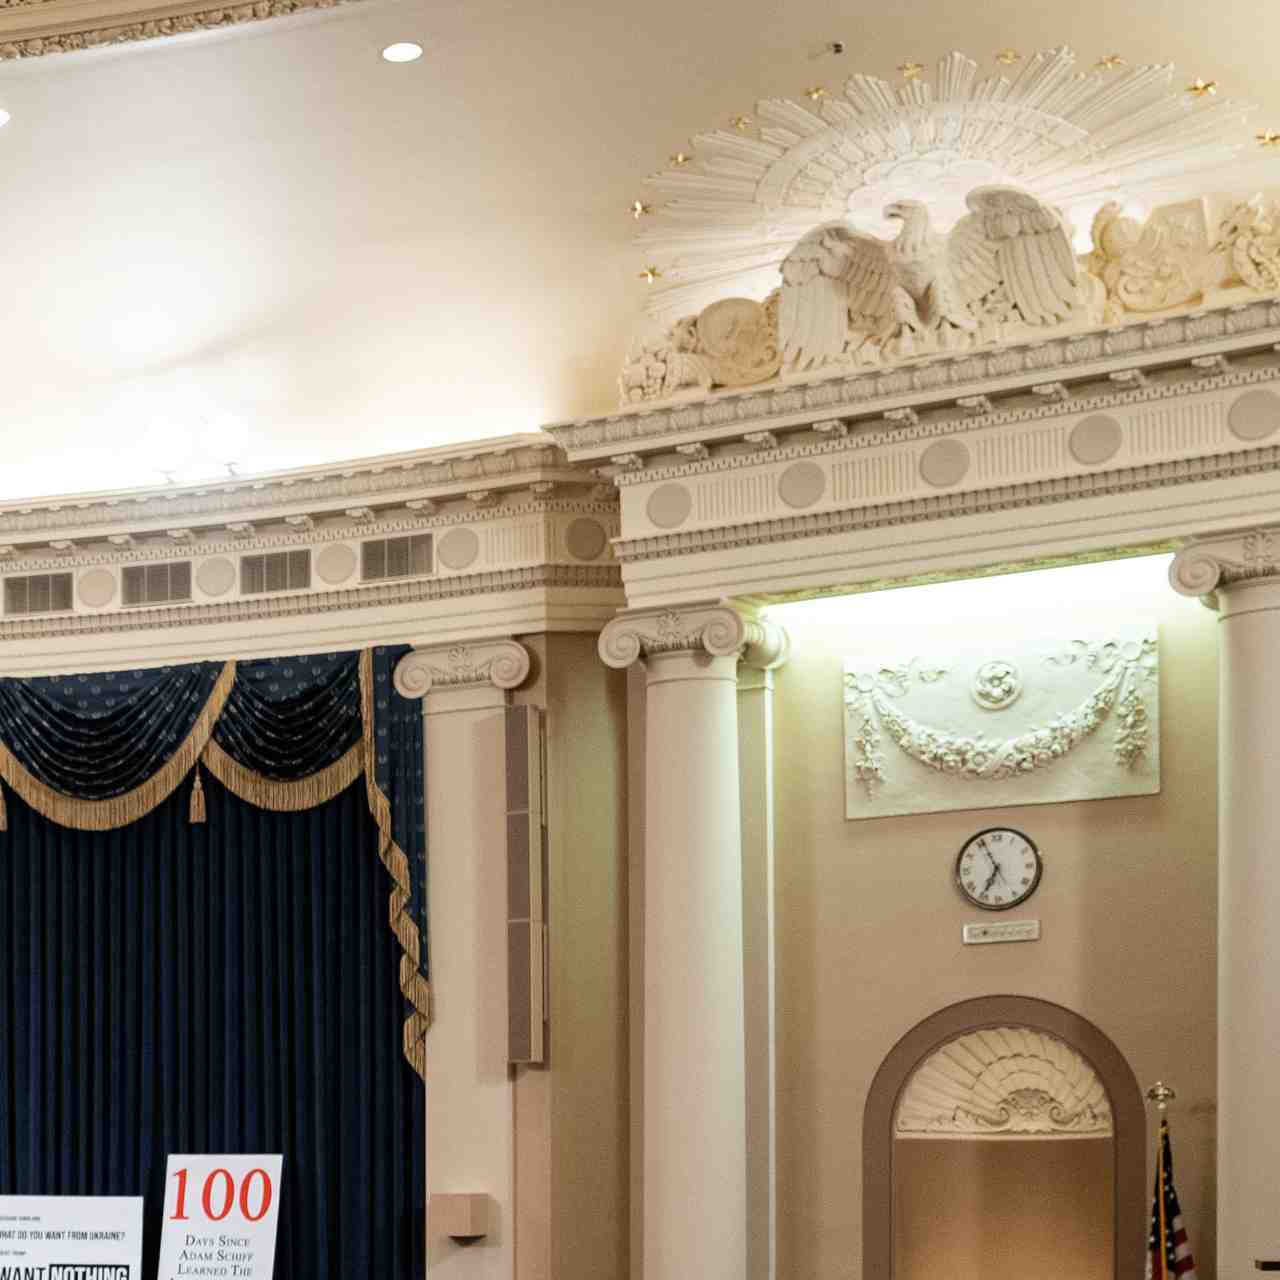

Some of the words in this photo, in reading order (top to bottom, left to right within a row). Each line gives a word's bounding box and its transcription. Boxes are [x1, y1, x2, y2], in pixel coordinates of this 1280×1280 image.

[169, 1168, 273, 1221] 100
[17, 1231, 28, 1240] DO
[29, 1231, 44, 1240] YOU
[45, 1231, 66, 1240] WANT
[67, 1231, 88, 1240] FROM
[89, 1231, 126, 1241] UKRAINE?
[185, 1234, 215, 1247] DAYS
[218, 1234, 251, 1247] SINCE
[179, 1249, 213, 1262] ADAM
[216, 1249, 255, 1263] SCHIFF
[177, 1263, 228, 1276] LEARNED
[230, 1264, 253, 1277] THE
